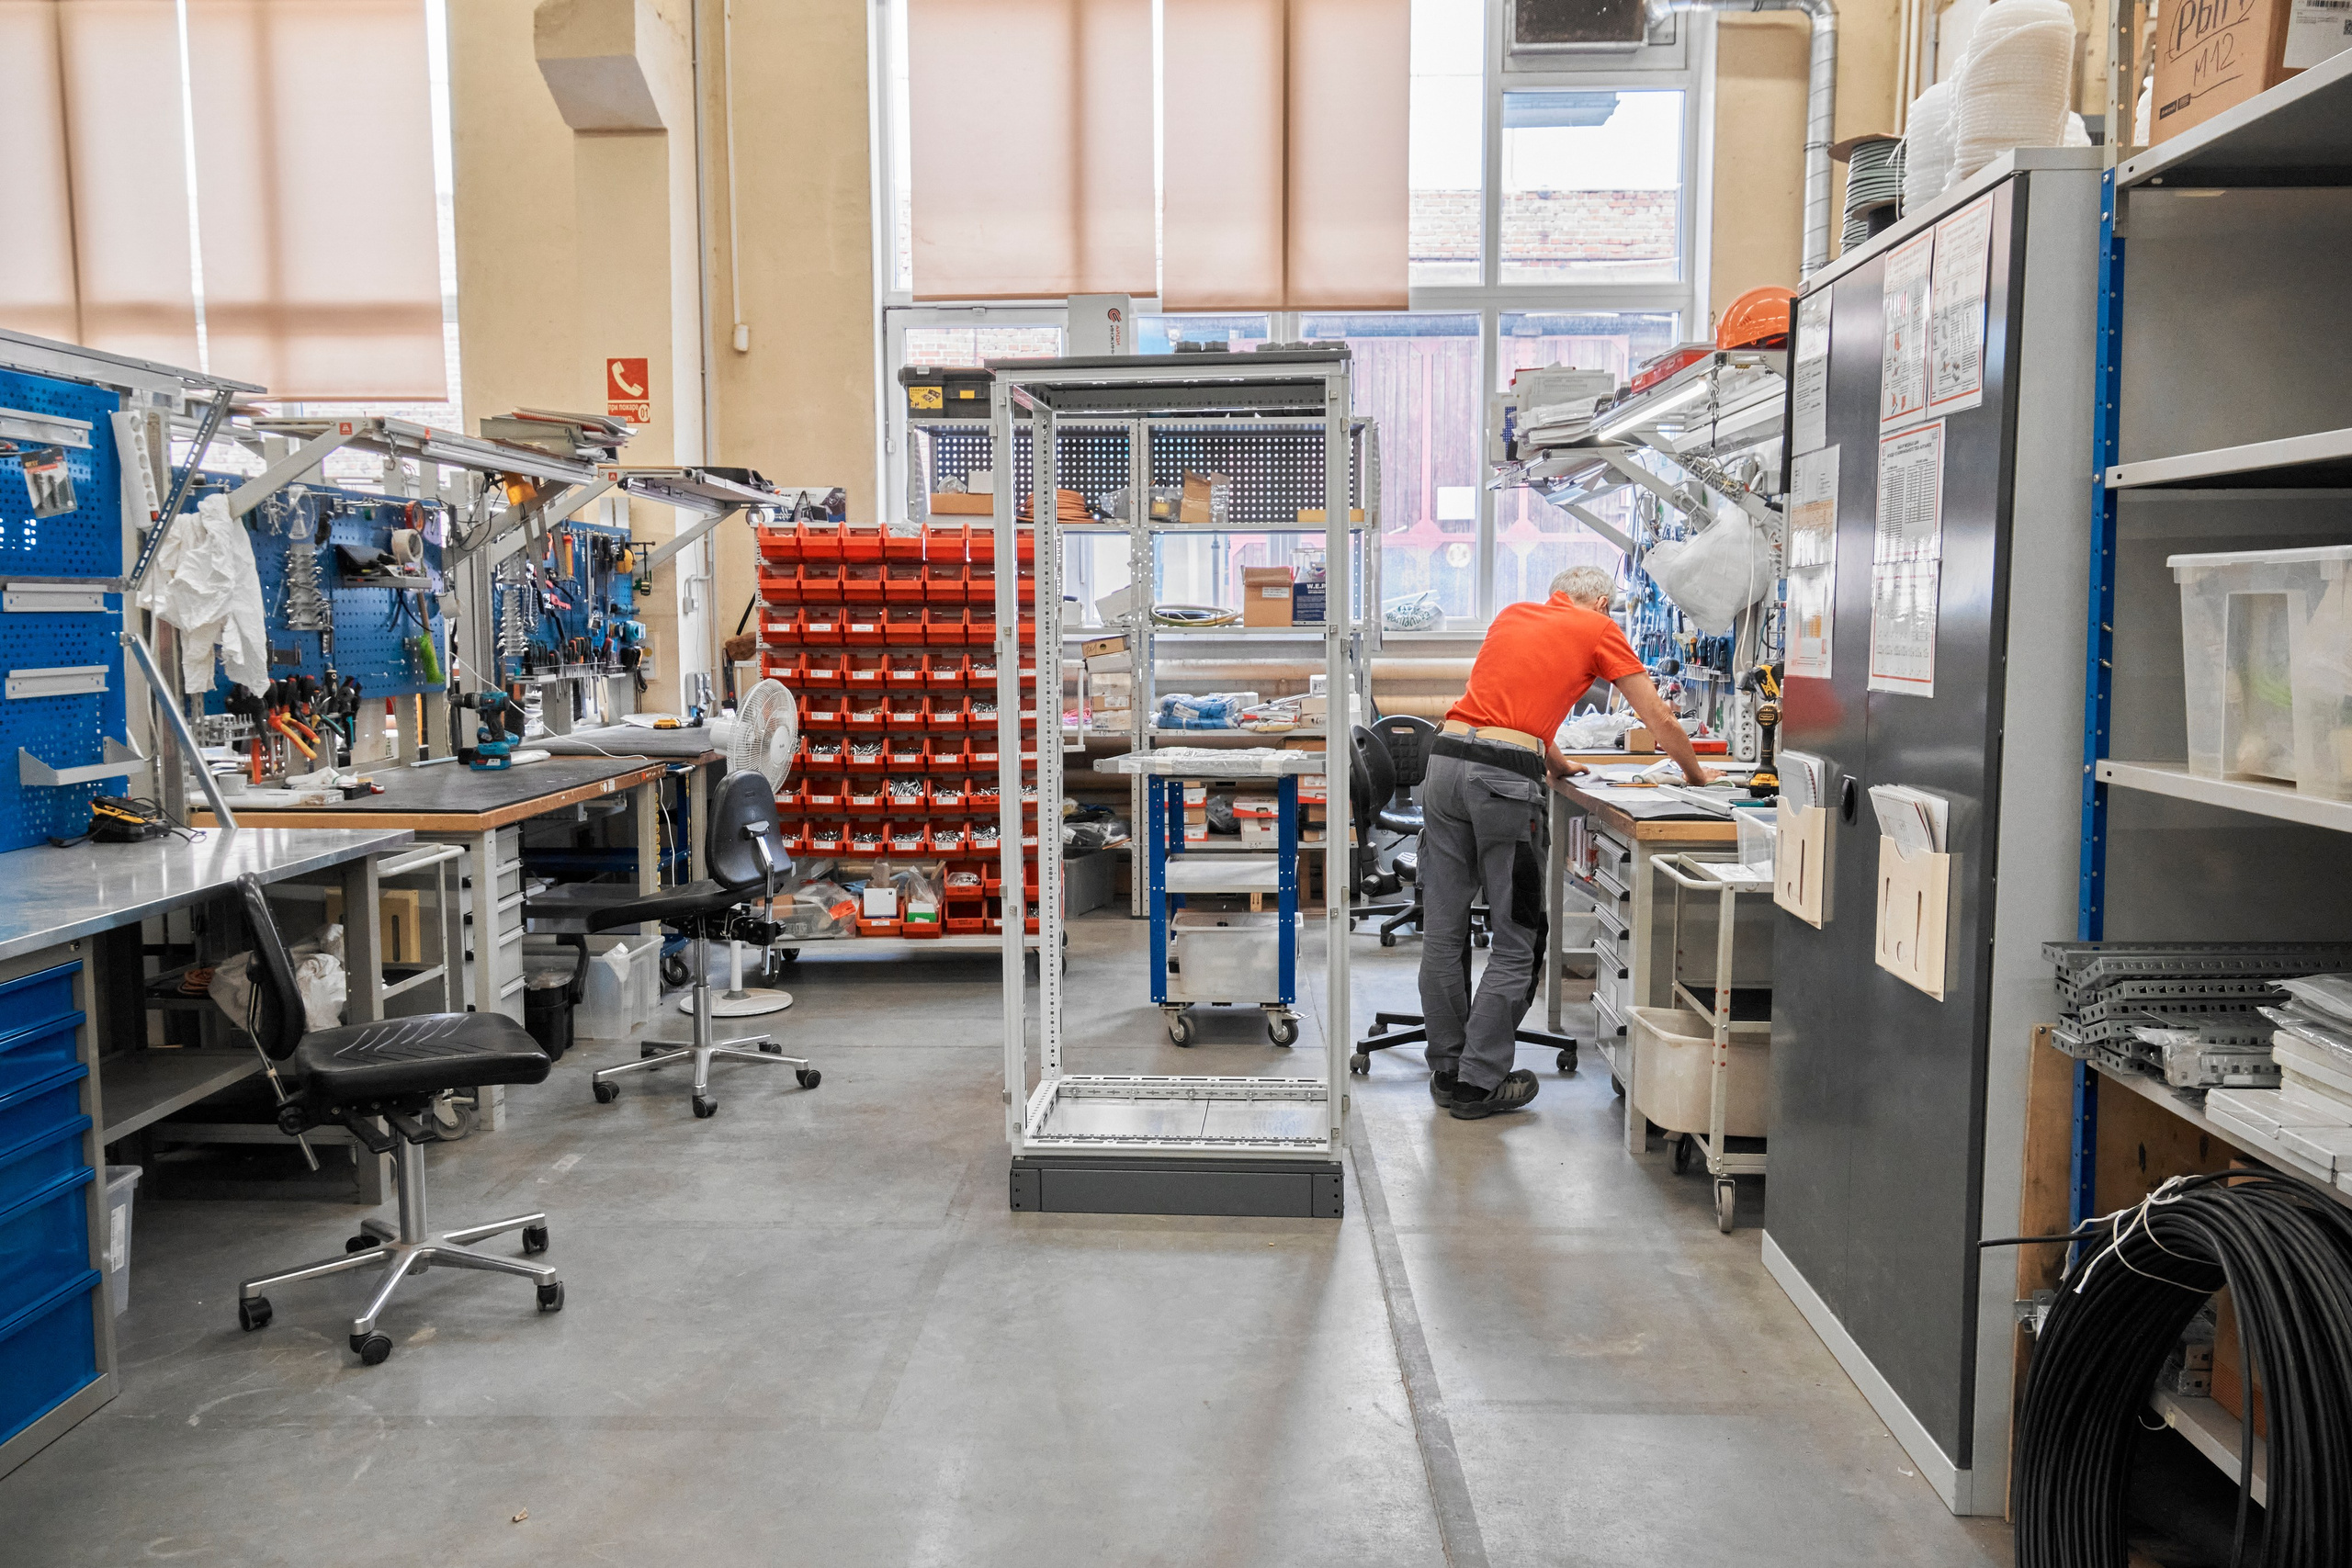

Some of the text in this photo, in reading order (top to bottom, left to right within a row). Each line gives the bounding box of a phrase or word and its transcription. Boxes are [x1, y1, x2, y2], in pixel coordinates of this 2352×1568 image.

[608, 404, 639, 412] при пожаре
[640, 408, 649, 418] 01
